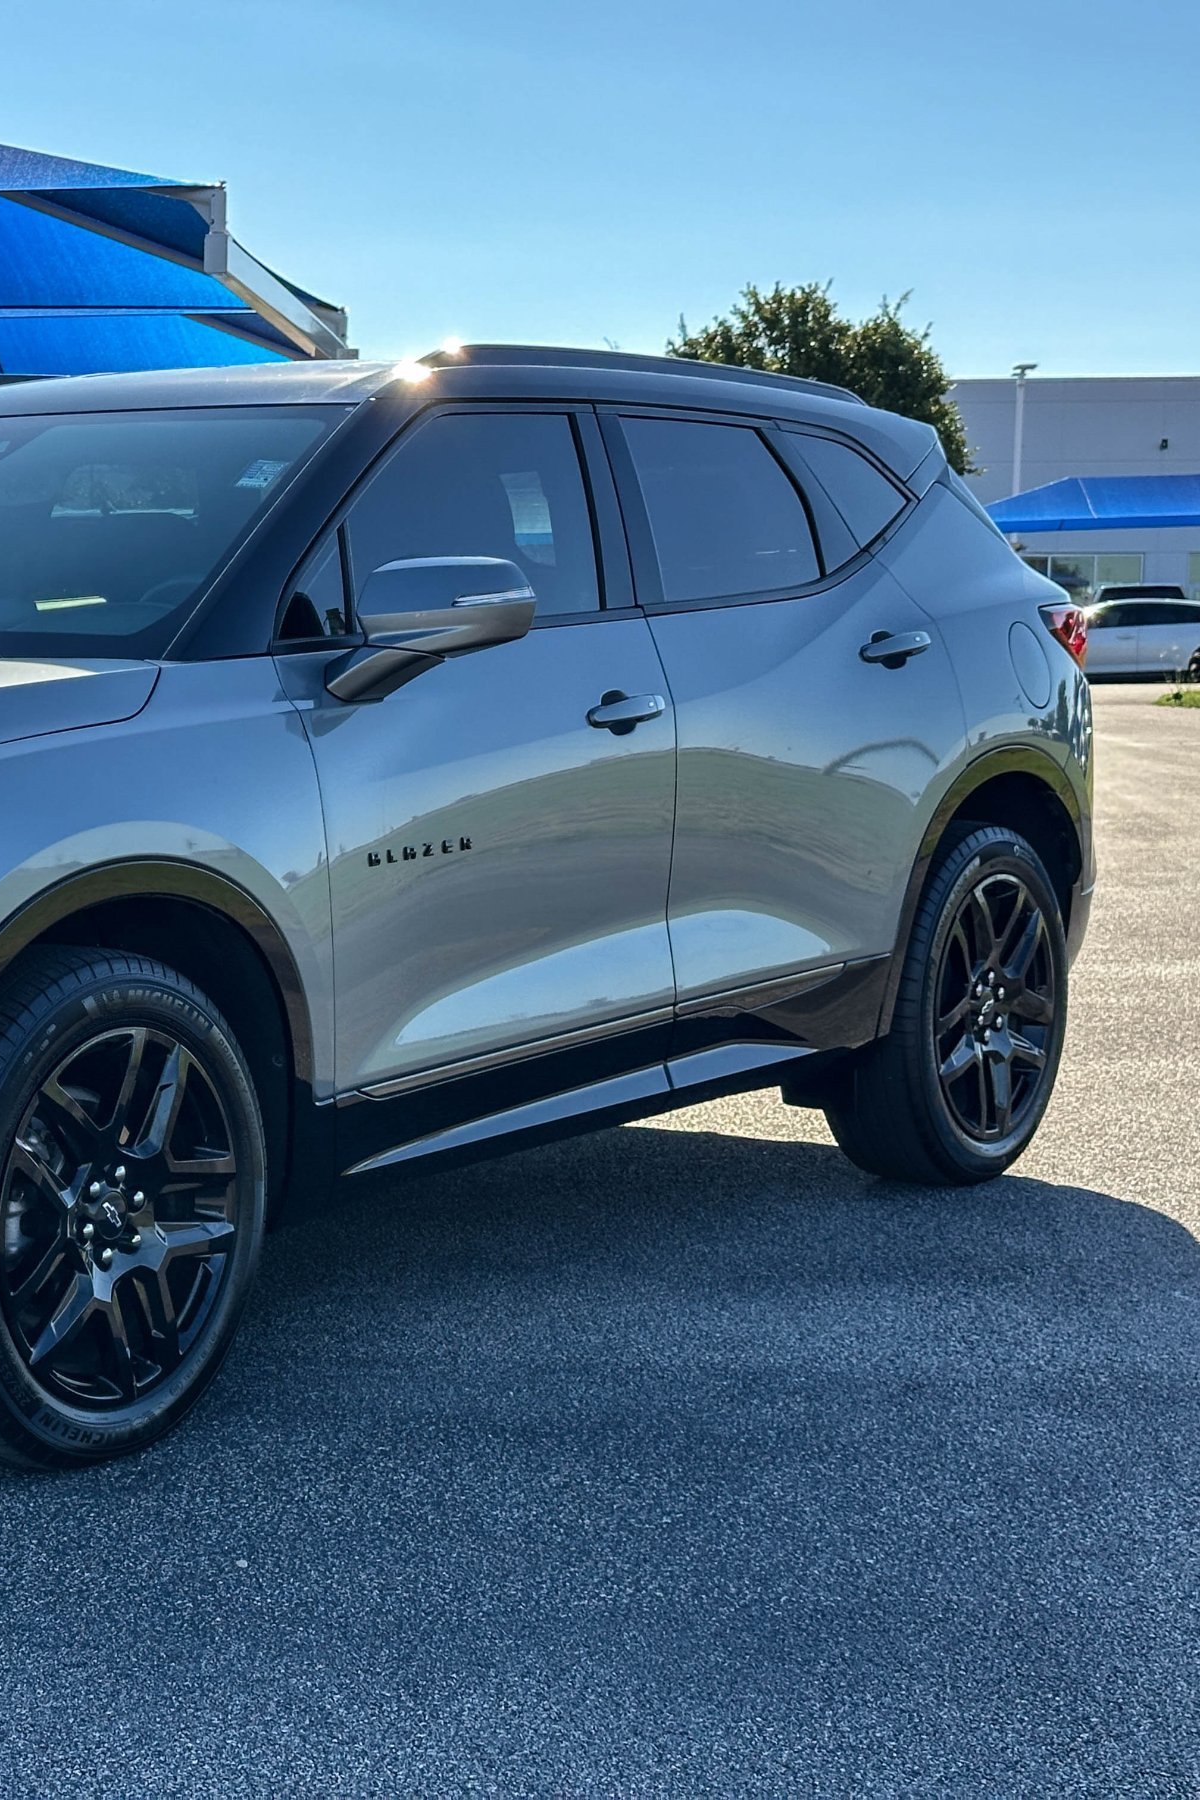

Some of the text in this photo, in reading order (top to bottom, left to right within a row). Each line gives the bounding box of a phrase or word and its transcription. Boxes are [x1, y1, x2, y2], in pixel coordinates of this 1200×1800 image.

[367, 836, 472, 867] BLAZER
[127, 988, 211, 1031] MICHELIN
[40, 1411, 118, 1446] ICHELIN
